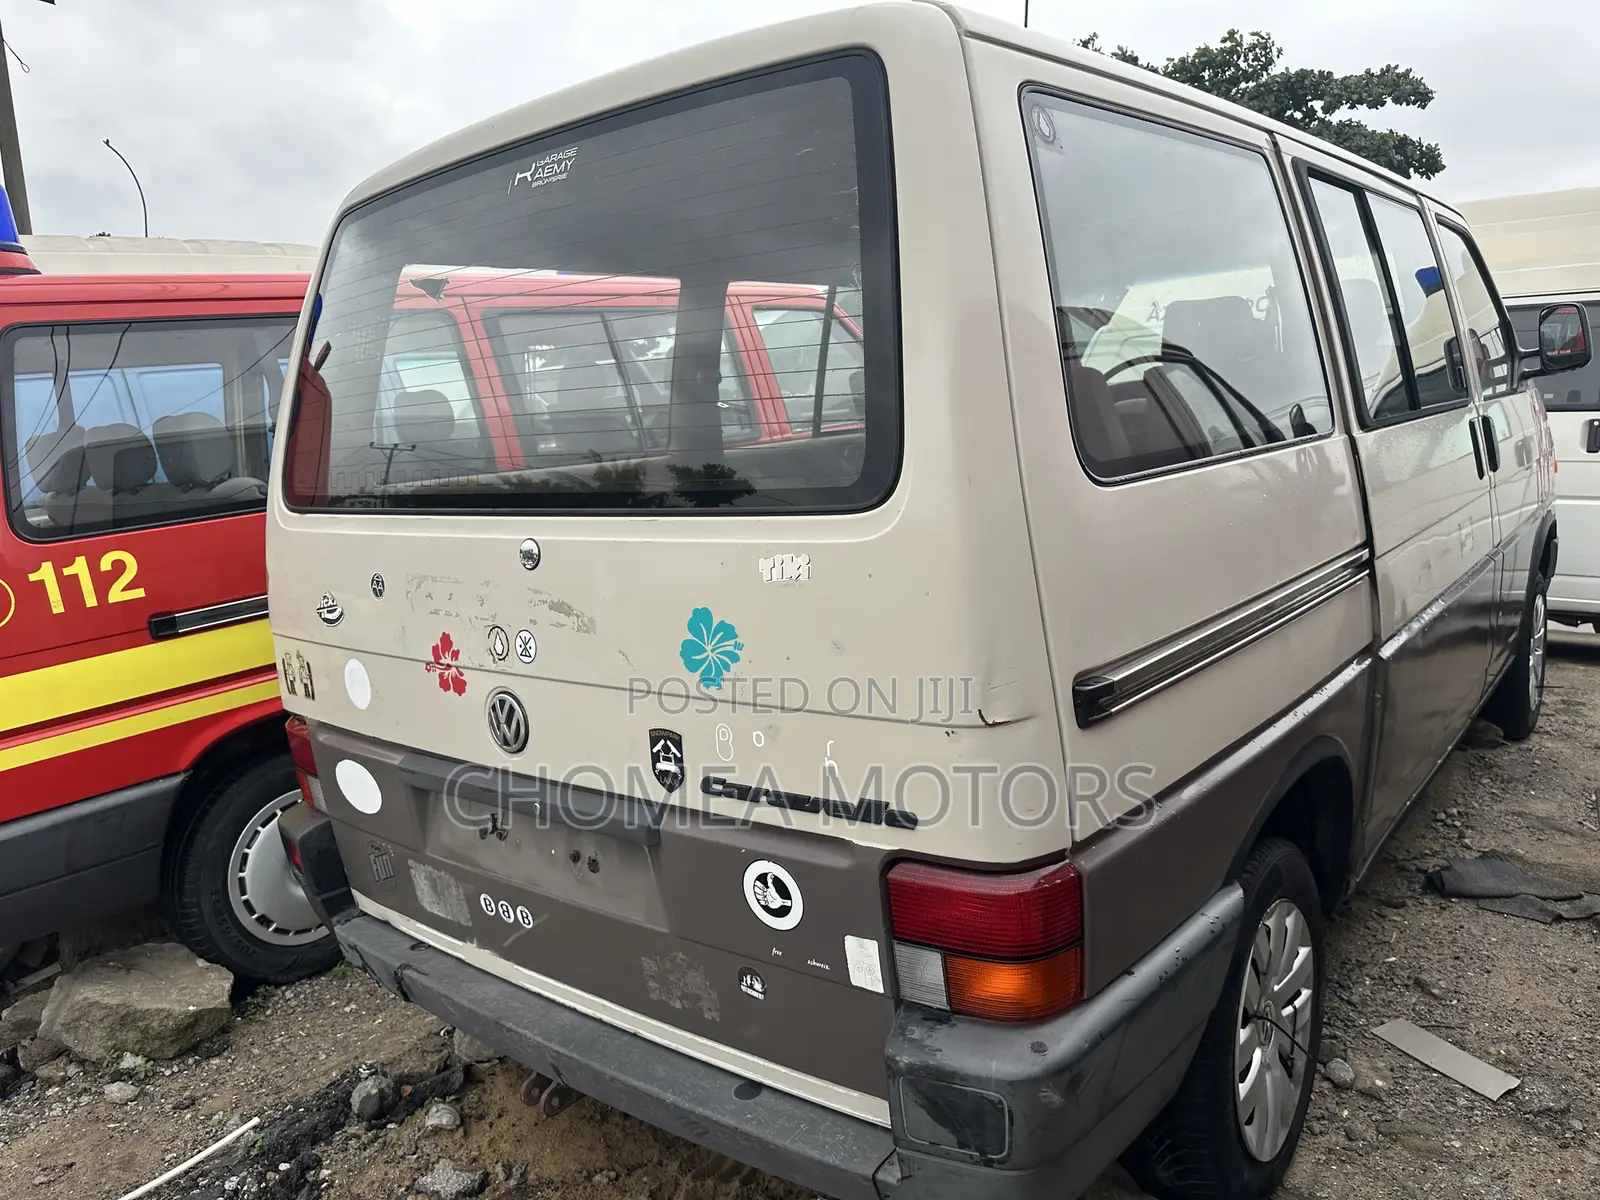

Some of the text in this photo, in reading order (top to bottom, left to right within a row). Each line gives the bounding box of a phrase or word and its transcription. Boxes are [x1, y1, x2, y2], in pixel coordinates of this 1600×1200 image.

[536, 146, 578, 167] GARAGE
[27, 549, 147, 615] 112
[650, 729, 681, 741] SNOWPARK
